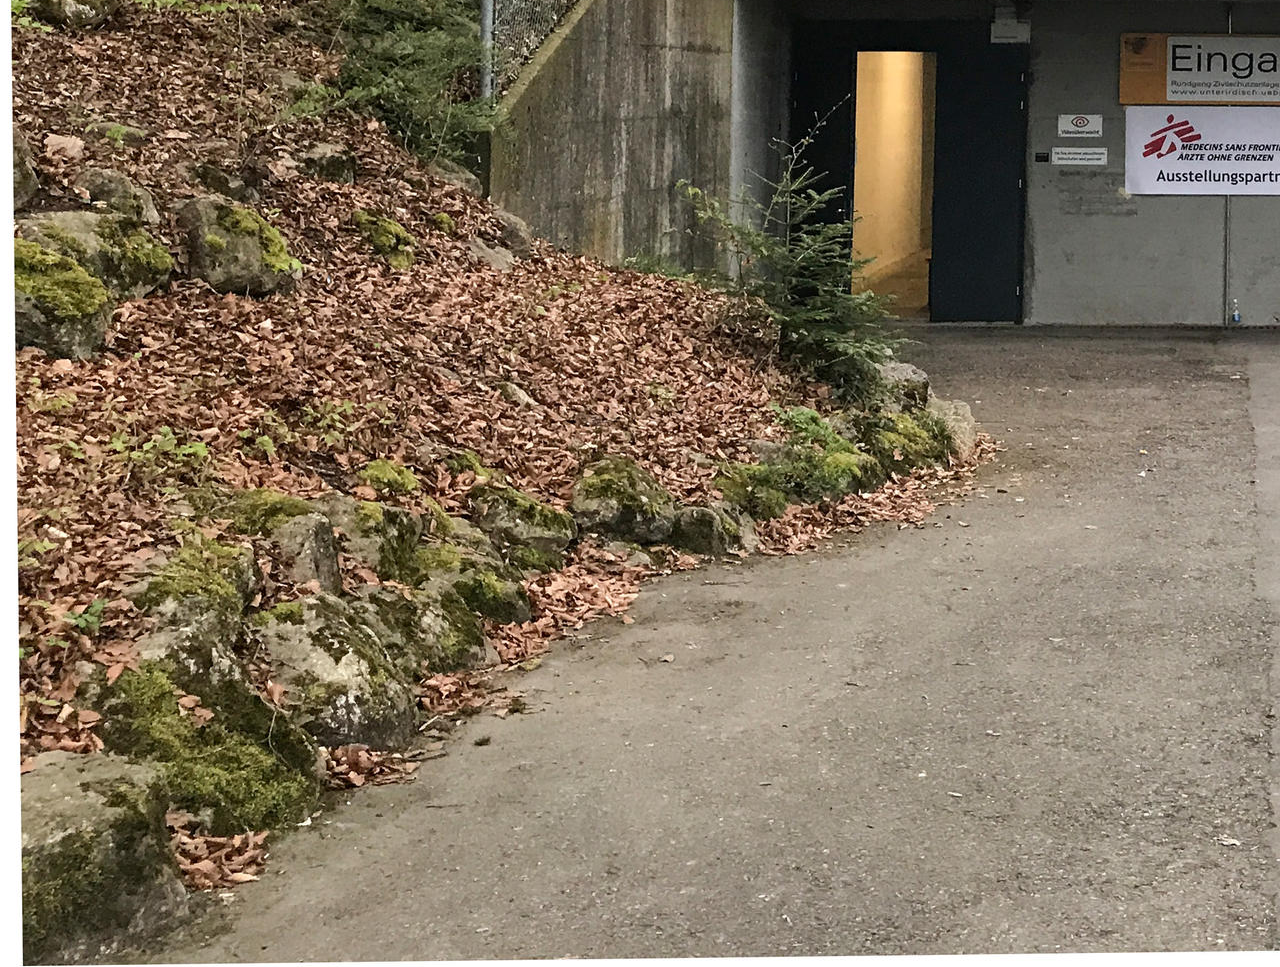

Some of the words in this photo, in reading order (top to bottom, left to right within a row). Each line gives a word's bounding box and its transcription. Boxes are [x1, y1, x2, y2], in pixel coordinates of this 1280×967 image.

[1180, 143, 1224, 151] MEDECINS
[1225, 144, 1247, 152] SANS
[1207, 154, 1233, 162] OHNE
[1234, 154, 1275, 162] GRENZEN
